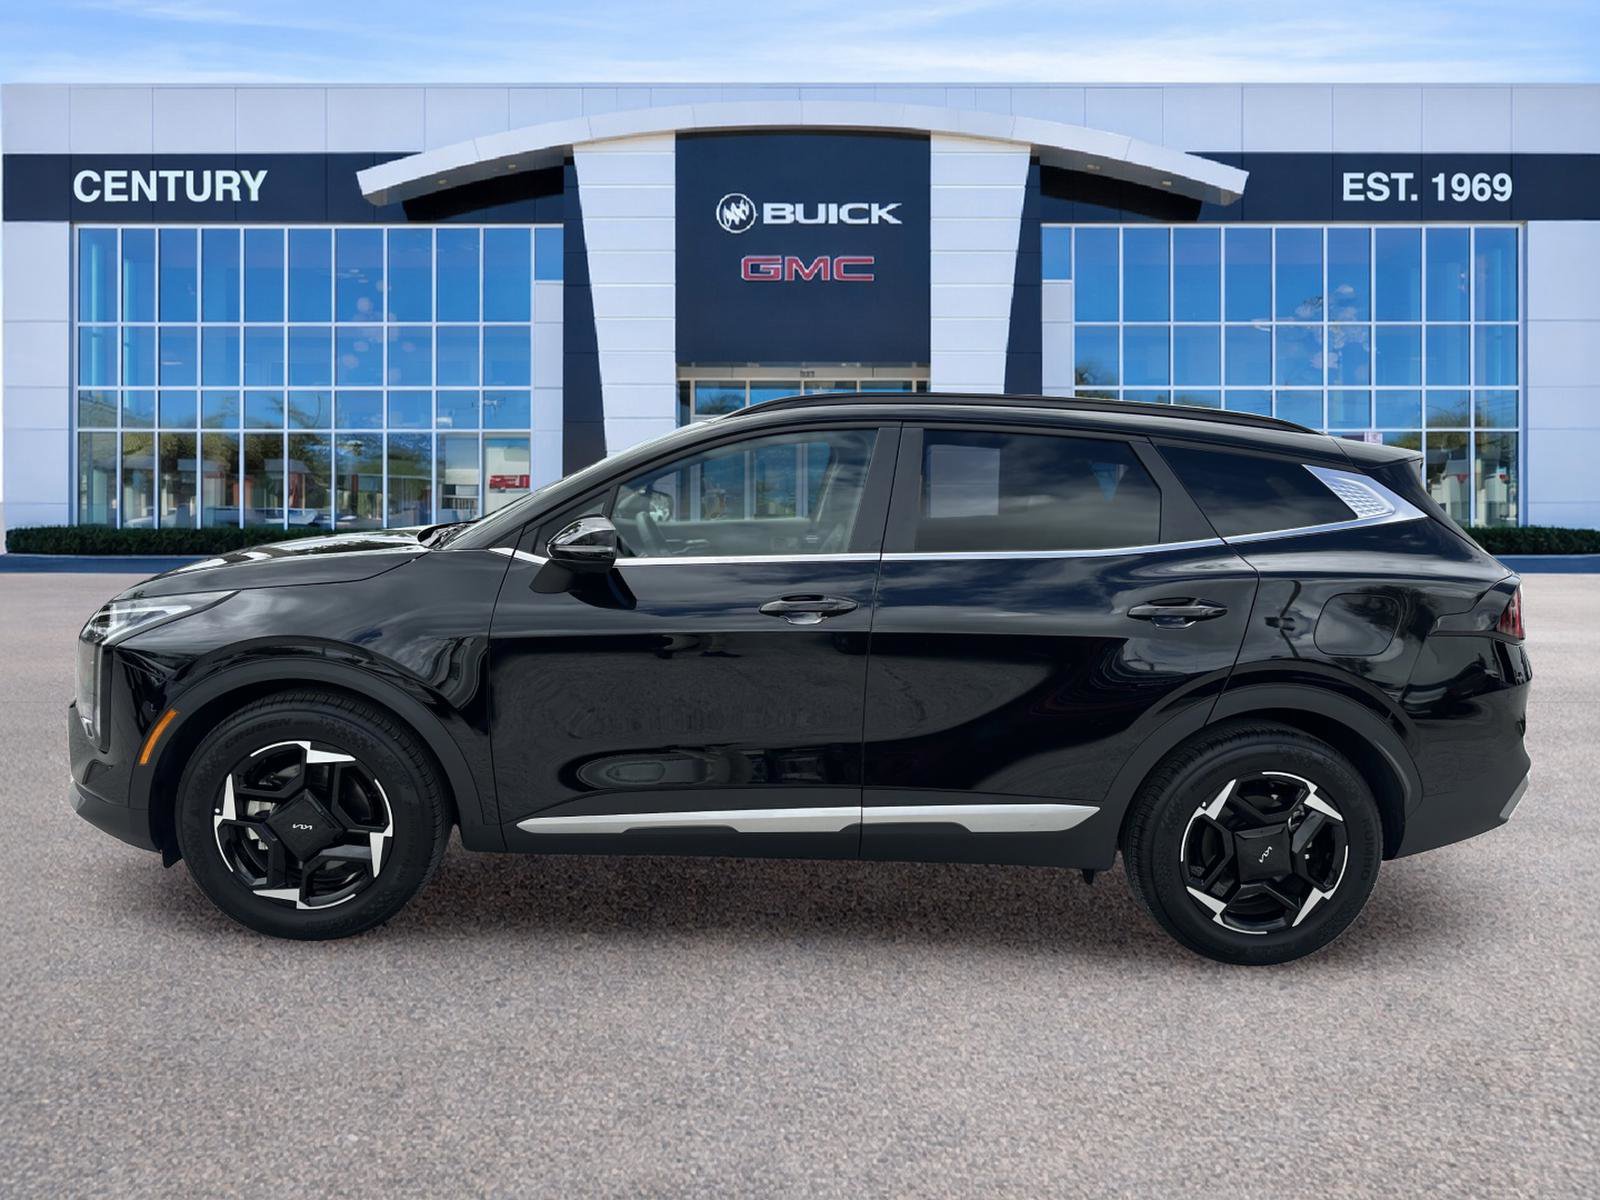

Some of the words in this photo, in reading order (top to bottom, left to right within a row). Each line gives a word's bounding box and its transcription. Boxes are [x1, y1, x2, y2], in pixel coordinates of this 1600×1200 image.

[73, 169, 268, 202] CENTURY
[1342, 171, 1418, 202] EST.
[1430, 171, 1513, 202] 1969
[763, 202, 902, 225] BUICK
[740, 255, 875, 281] GMC
